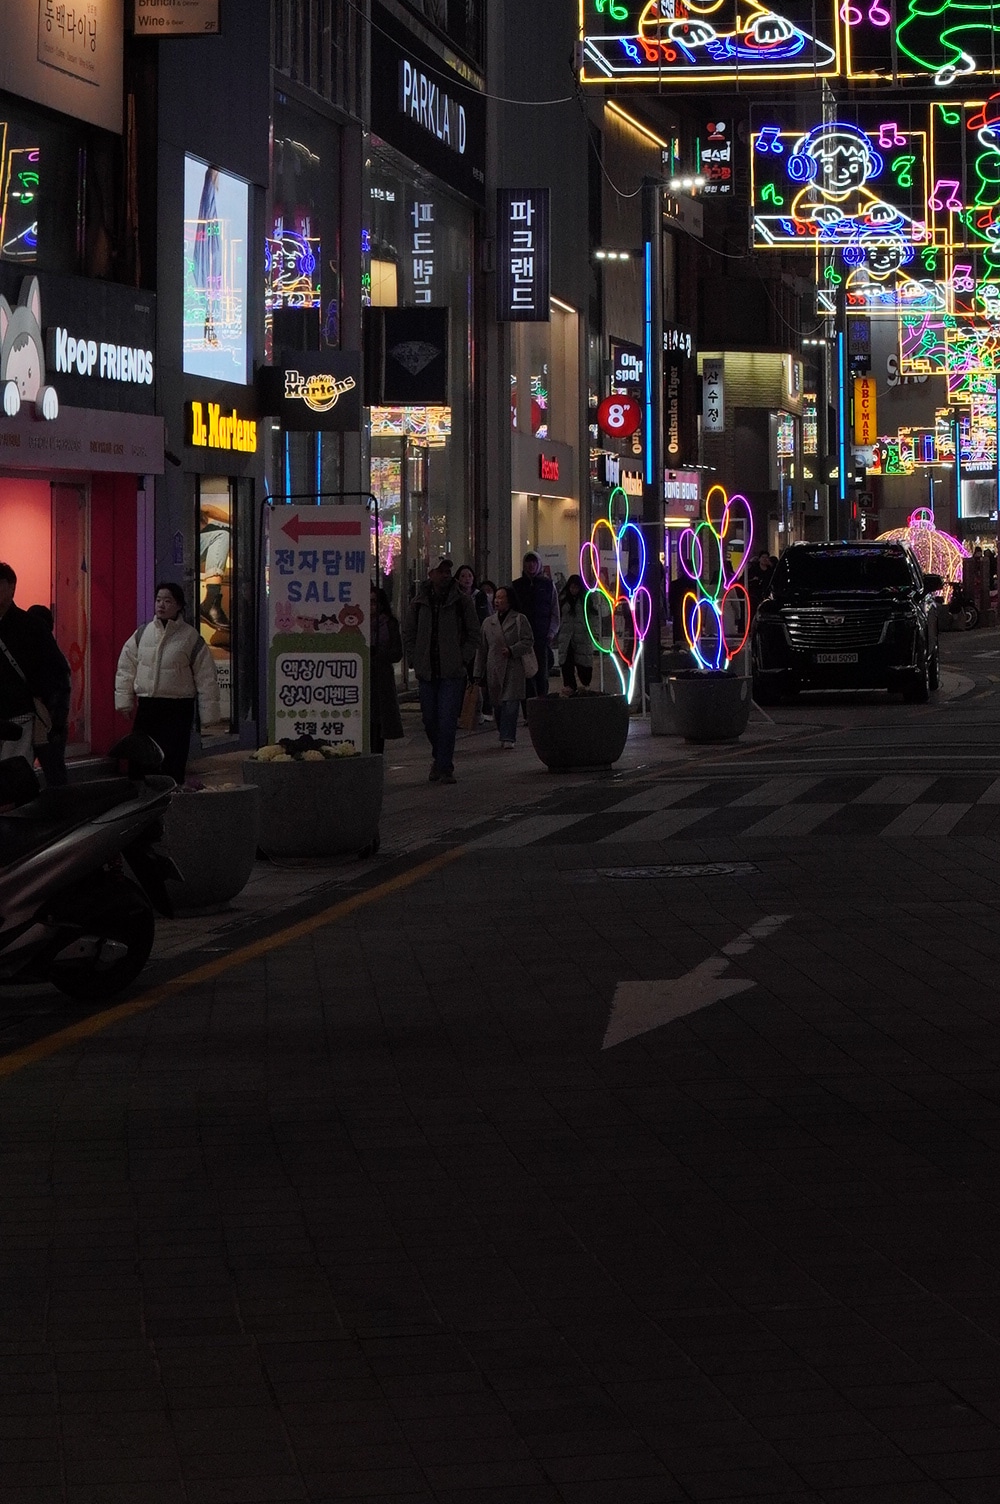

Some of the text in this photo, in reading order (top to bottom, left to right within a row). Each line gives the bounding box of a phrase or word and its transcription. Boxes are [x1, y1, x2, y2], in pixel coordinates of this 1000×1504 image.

[138, 15, 165, 26] Wine
[205, 21, 216, 30] 2F
[510, 199, 536, 310] 파크랜드
[55, 326, 153, 385] KPOP FRIENDS
[621, 353, 636, 366] On
[285, 375, 356, 399] Martens
[667, 366, 680, 398] Tiger
[706, 371, 719, 423] 산수정
[207, 402, 257, 453] Martens
[667, 401, 680, 454] Onitsuka
[275, 549, 366, 575] 전자담배
[287, 581, 352, 603] SALE
[281, 660, 316, 681] 액상
[325, 659, 357, 679] 기기
[279, 685, 359, 706] 상시 이벤트
[294, 721, 345, 736] 친절 상담
